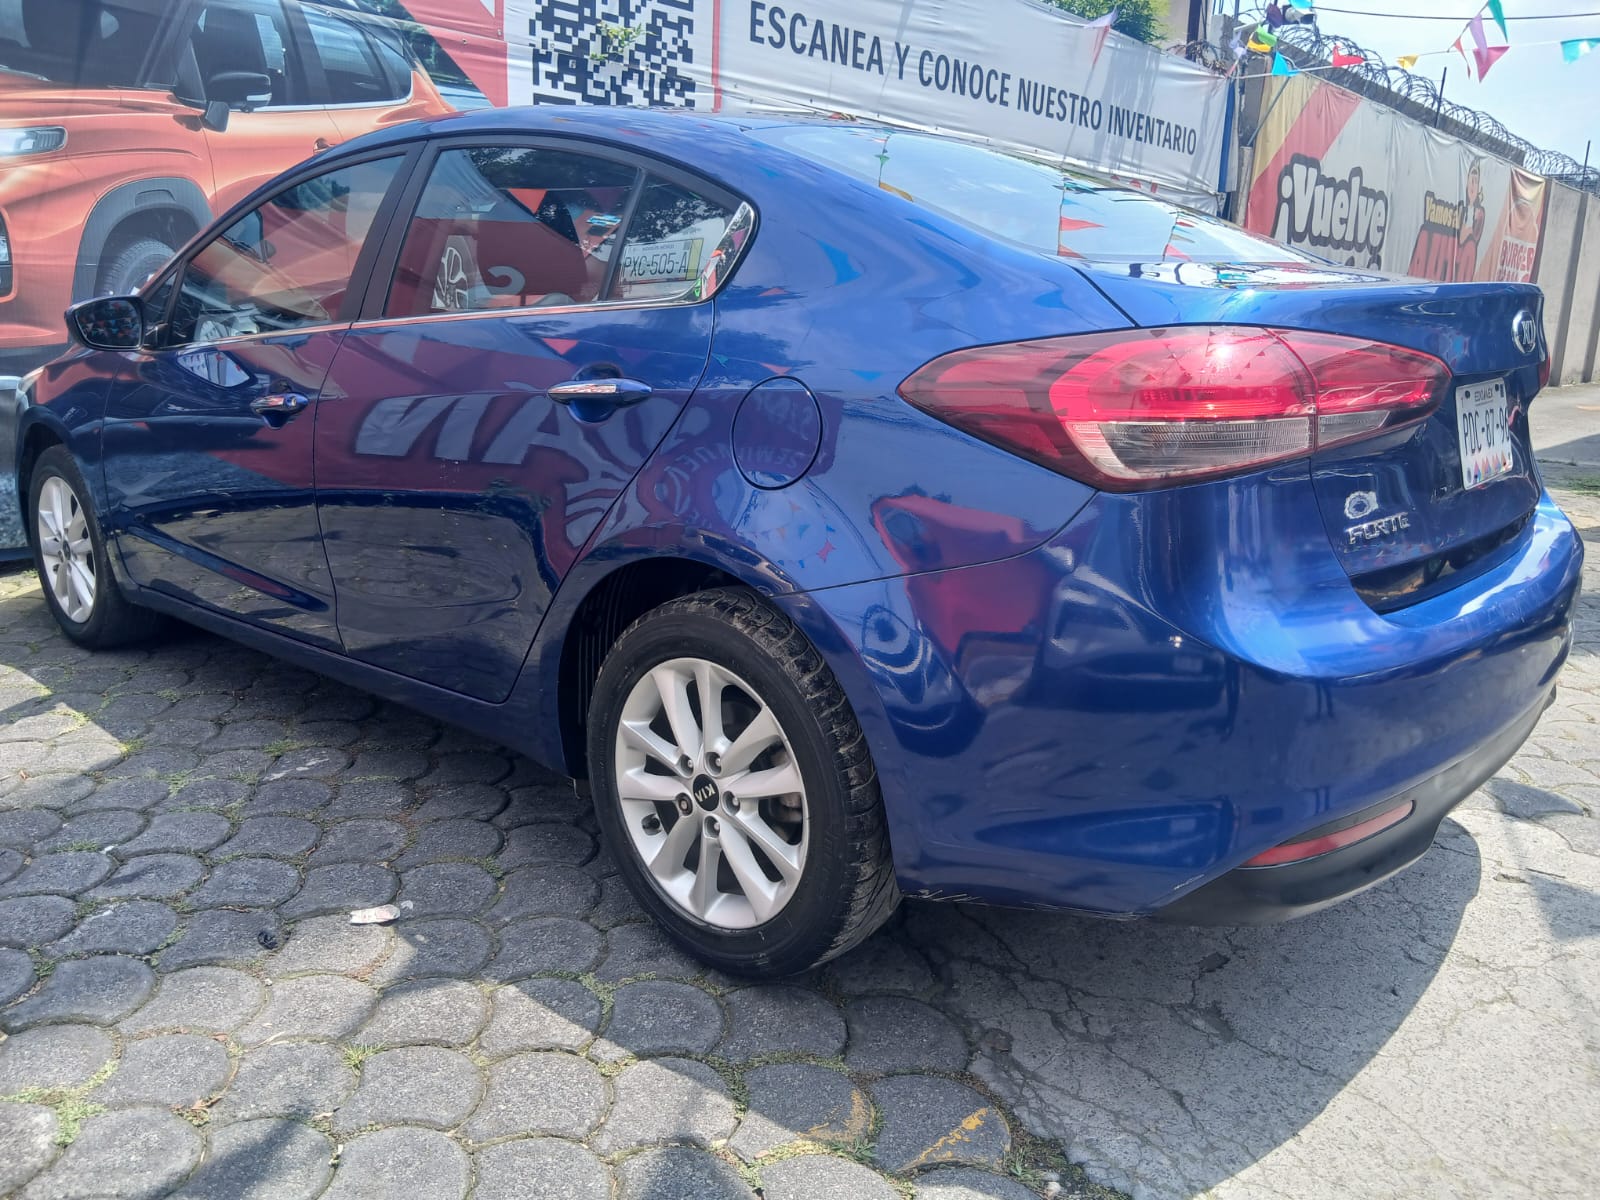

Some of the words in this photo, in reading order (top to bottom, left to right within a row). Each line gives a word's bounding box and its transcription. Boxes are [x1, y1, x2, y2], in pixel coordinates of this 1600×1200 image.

[749, 1, 884, 75] ESCANEA
[894, 41, 911, 80] Y
[919, 50, 1010, 107] CONOCE
[1017, 78, 1103, 131] NUESTRO
[1108, 104, 1198, 156] INVENTARIO
[623, 251, 688, 277] PXC-505-A
[1345, 512, 1411, 544] FORTE
[695, 783, 716, 802] KIA
